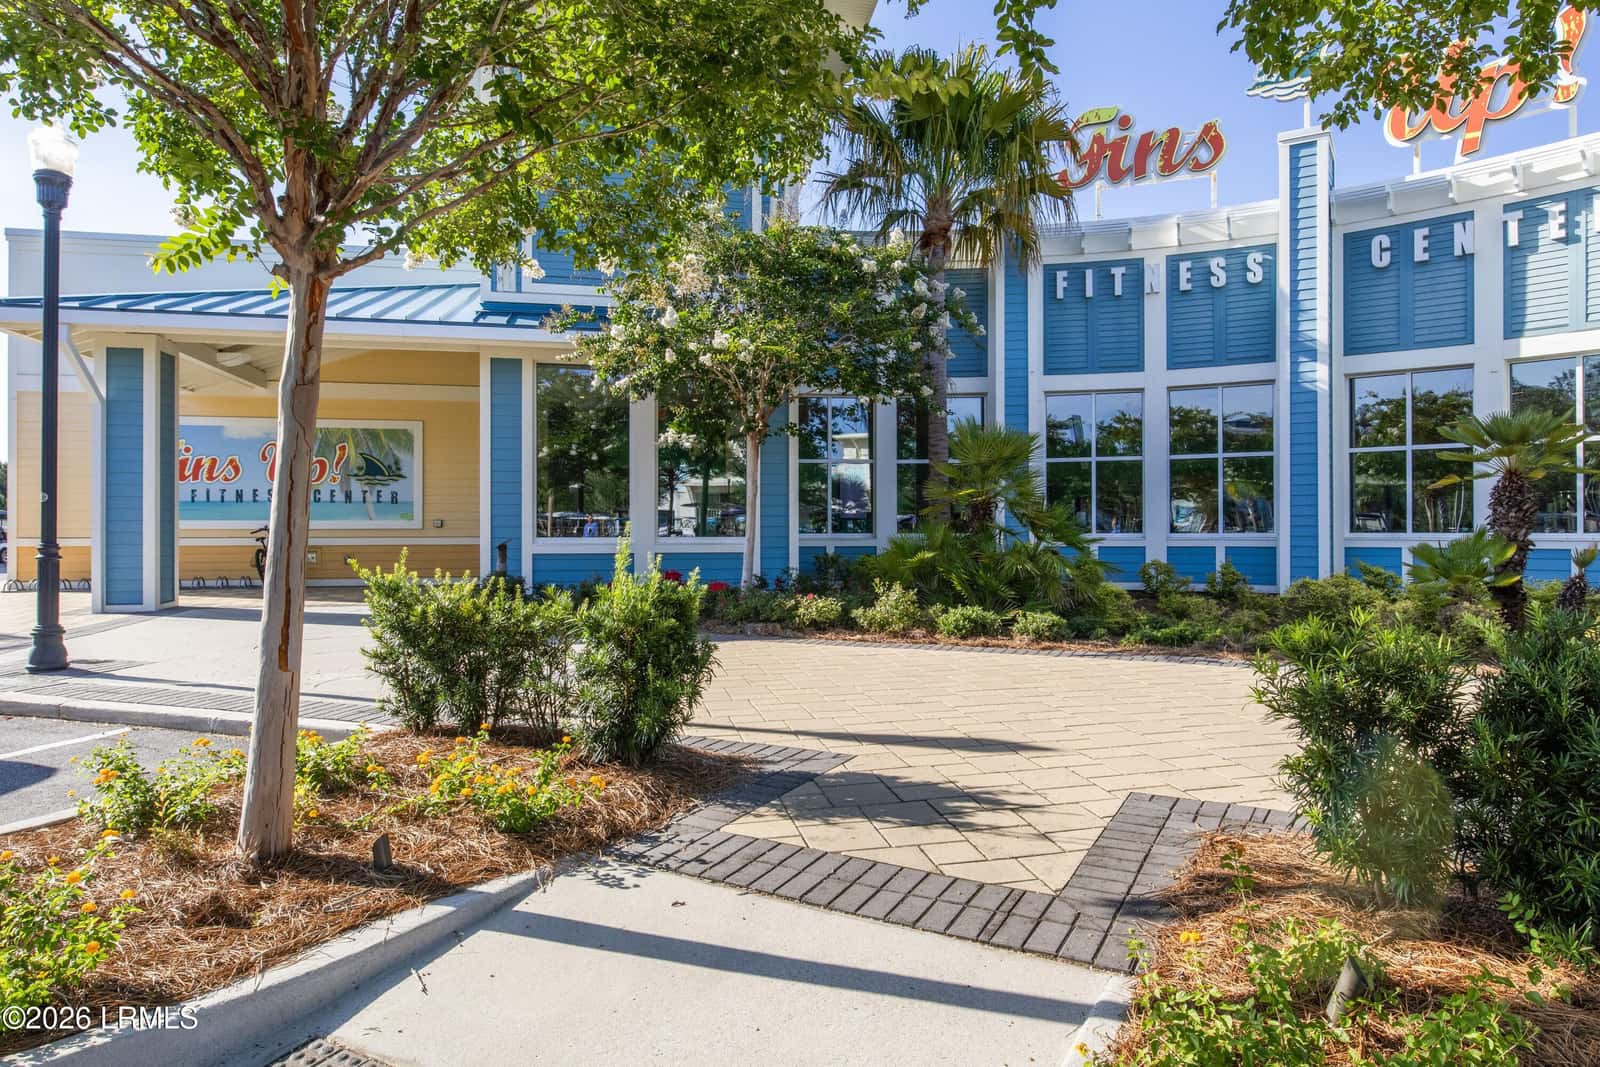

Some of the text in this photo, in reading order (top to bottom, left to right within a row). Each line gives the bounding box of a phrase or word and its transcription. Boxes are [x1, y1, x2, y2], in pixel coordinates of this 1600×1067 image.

[1056, 105, 1227, 189] Fins
[1055, 251, 1263, 299] FITNESS
[177, 440, 242, 483] ins
[190, 488, 399, 505] FITNES CENTER
